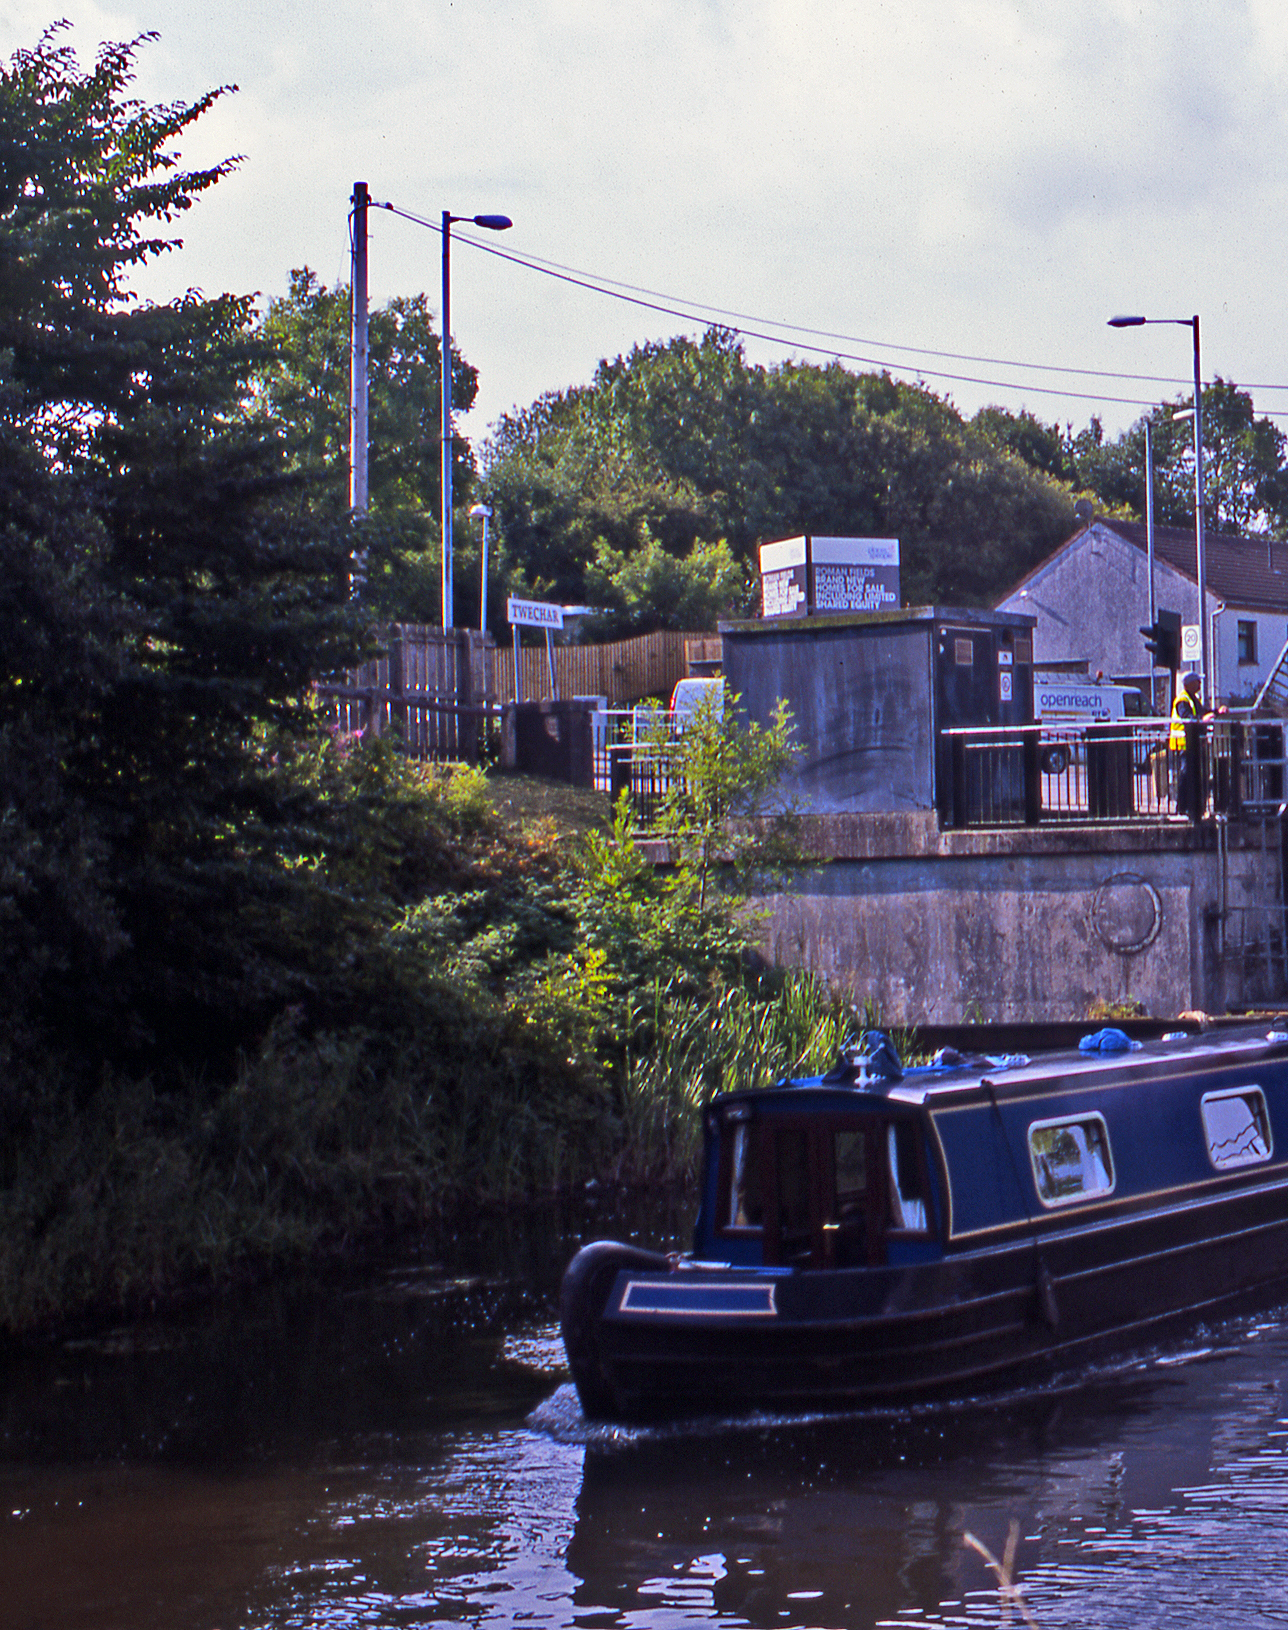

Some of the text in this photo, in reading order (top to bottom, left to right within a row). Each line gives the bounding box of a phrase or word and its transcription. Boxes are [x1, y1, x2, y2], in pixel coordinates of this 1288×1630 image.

[815, 567, 875, 578] ROMAN FIELDS
[815, 576, 866, 586] BRAND NEW
[815, 584, 885, 595] HOMES FOR SALE
[815, 592, 897, 602] INCLUDING LIMITED
[815, 601, 880, 610] SHARED EQUITY
[511, 604, 560, 623] TWECHAR
[1040, 694, 1102, 708] openreach
